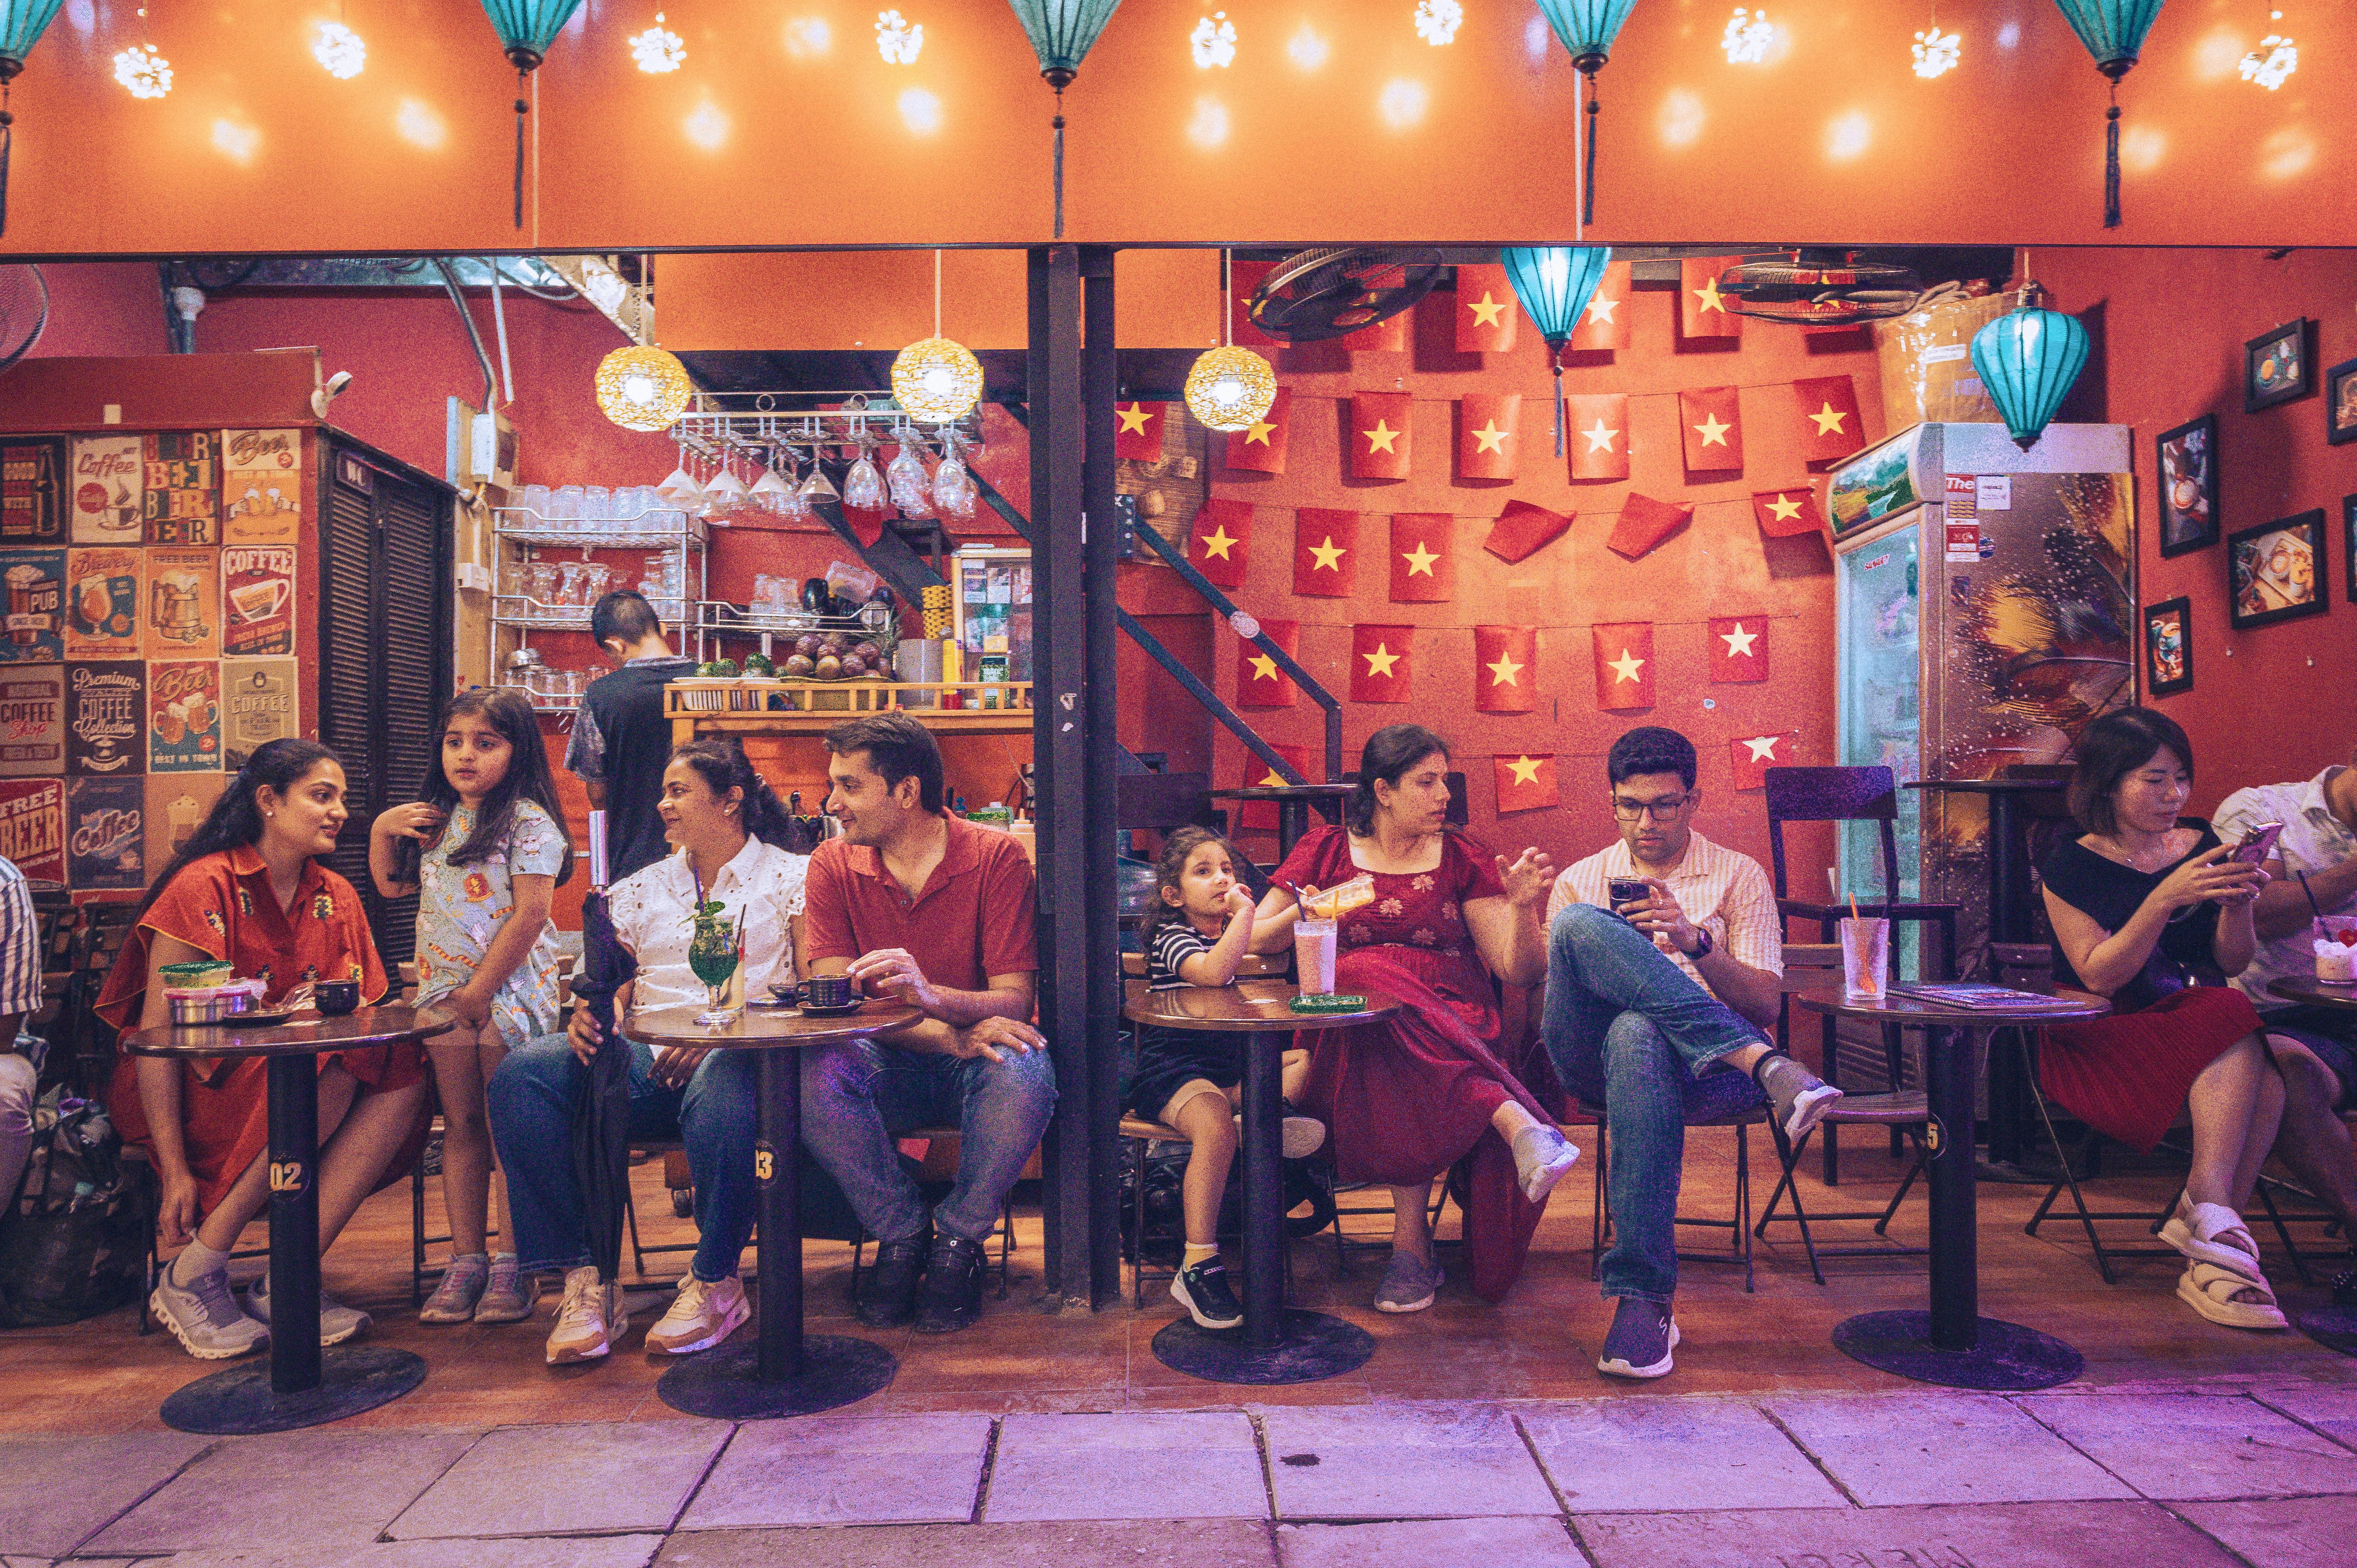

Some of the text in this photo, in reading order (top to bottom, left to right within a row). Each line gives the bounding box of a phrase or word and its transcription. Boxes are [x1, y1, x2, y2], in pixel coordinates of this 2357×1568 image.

[77, 453, 137, 479] Coffee
[346, 460, 366, 487] WC
[1946, 477, 1975, 490] The
[226, 549, 292, 575] COFFEE
[31, 590, 59, 613] PUB
[72, 668, 141, 691] Premium
[153, 667, 216, 702] Beer
[1, 702, 56, 723] COFFEE
[80, 698, 133, 719] COFFEE
[231, 694, 289, 715] COFFEE
[8, 719, 48, 742] Shop
[72, 716, 136, 742] Collection
[0, 786, 57, 819] FREE
[0, 805, 59, 861] BEER
[72, 809, 140, 857] Coffee
[270, 1162, 302, 1191] 02
[756, 1150, 773, 1180] 3
